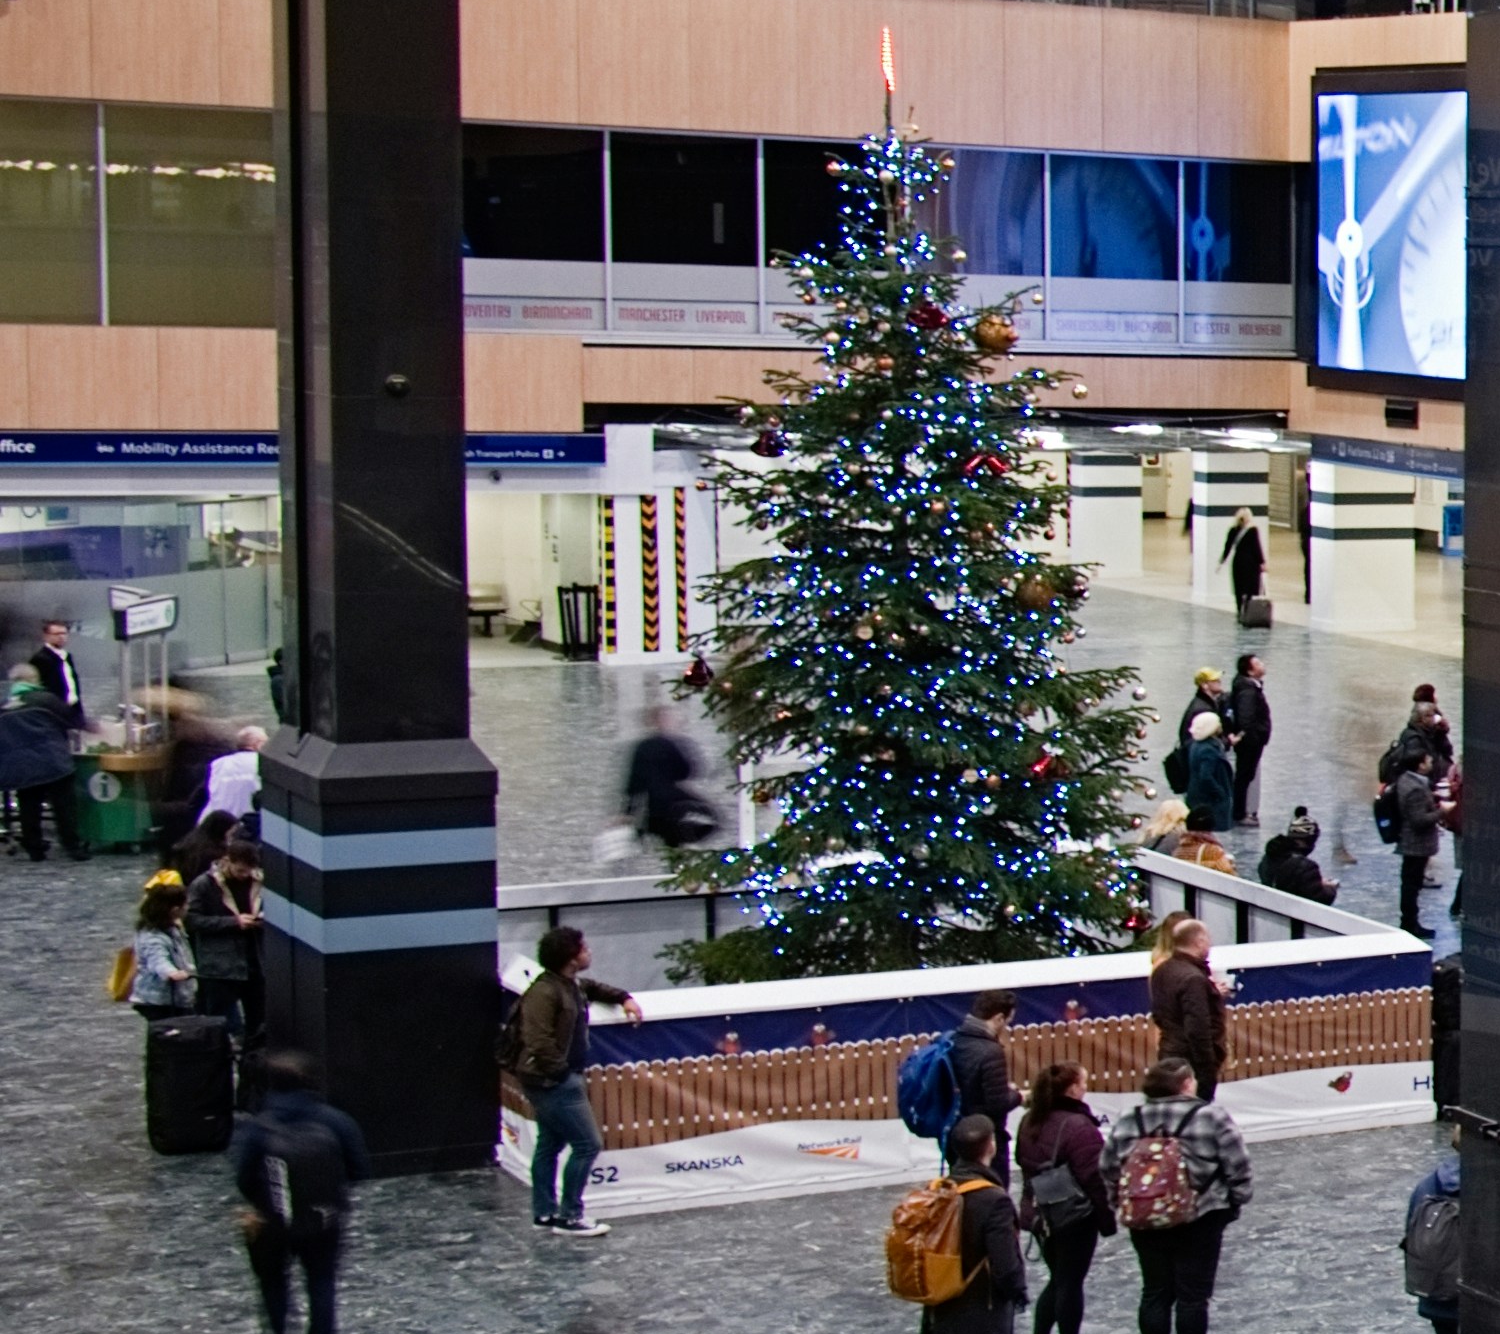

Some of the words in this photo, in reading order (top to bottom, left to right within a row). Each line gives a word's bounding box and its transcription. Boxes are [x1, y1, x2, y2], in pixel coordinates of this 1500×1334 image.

[121, 442, 177, 456] Mobility
[182, 443, 254, 454] Assistance
[476, 450, 513, 458] Transport
[665, 1154, 744, 1174] SKANSKA
